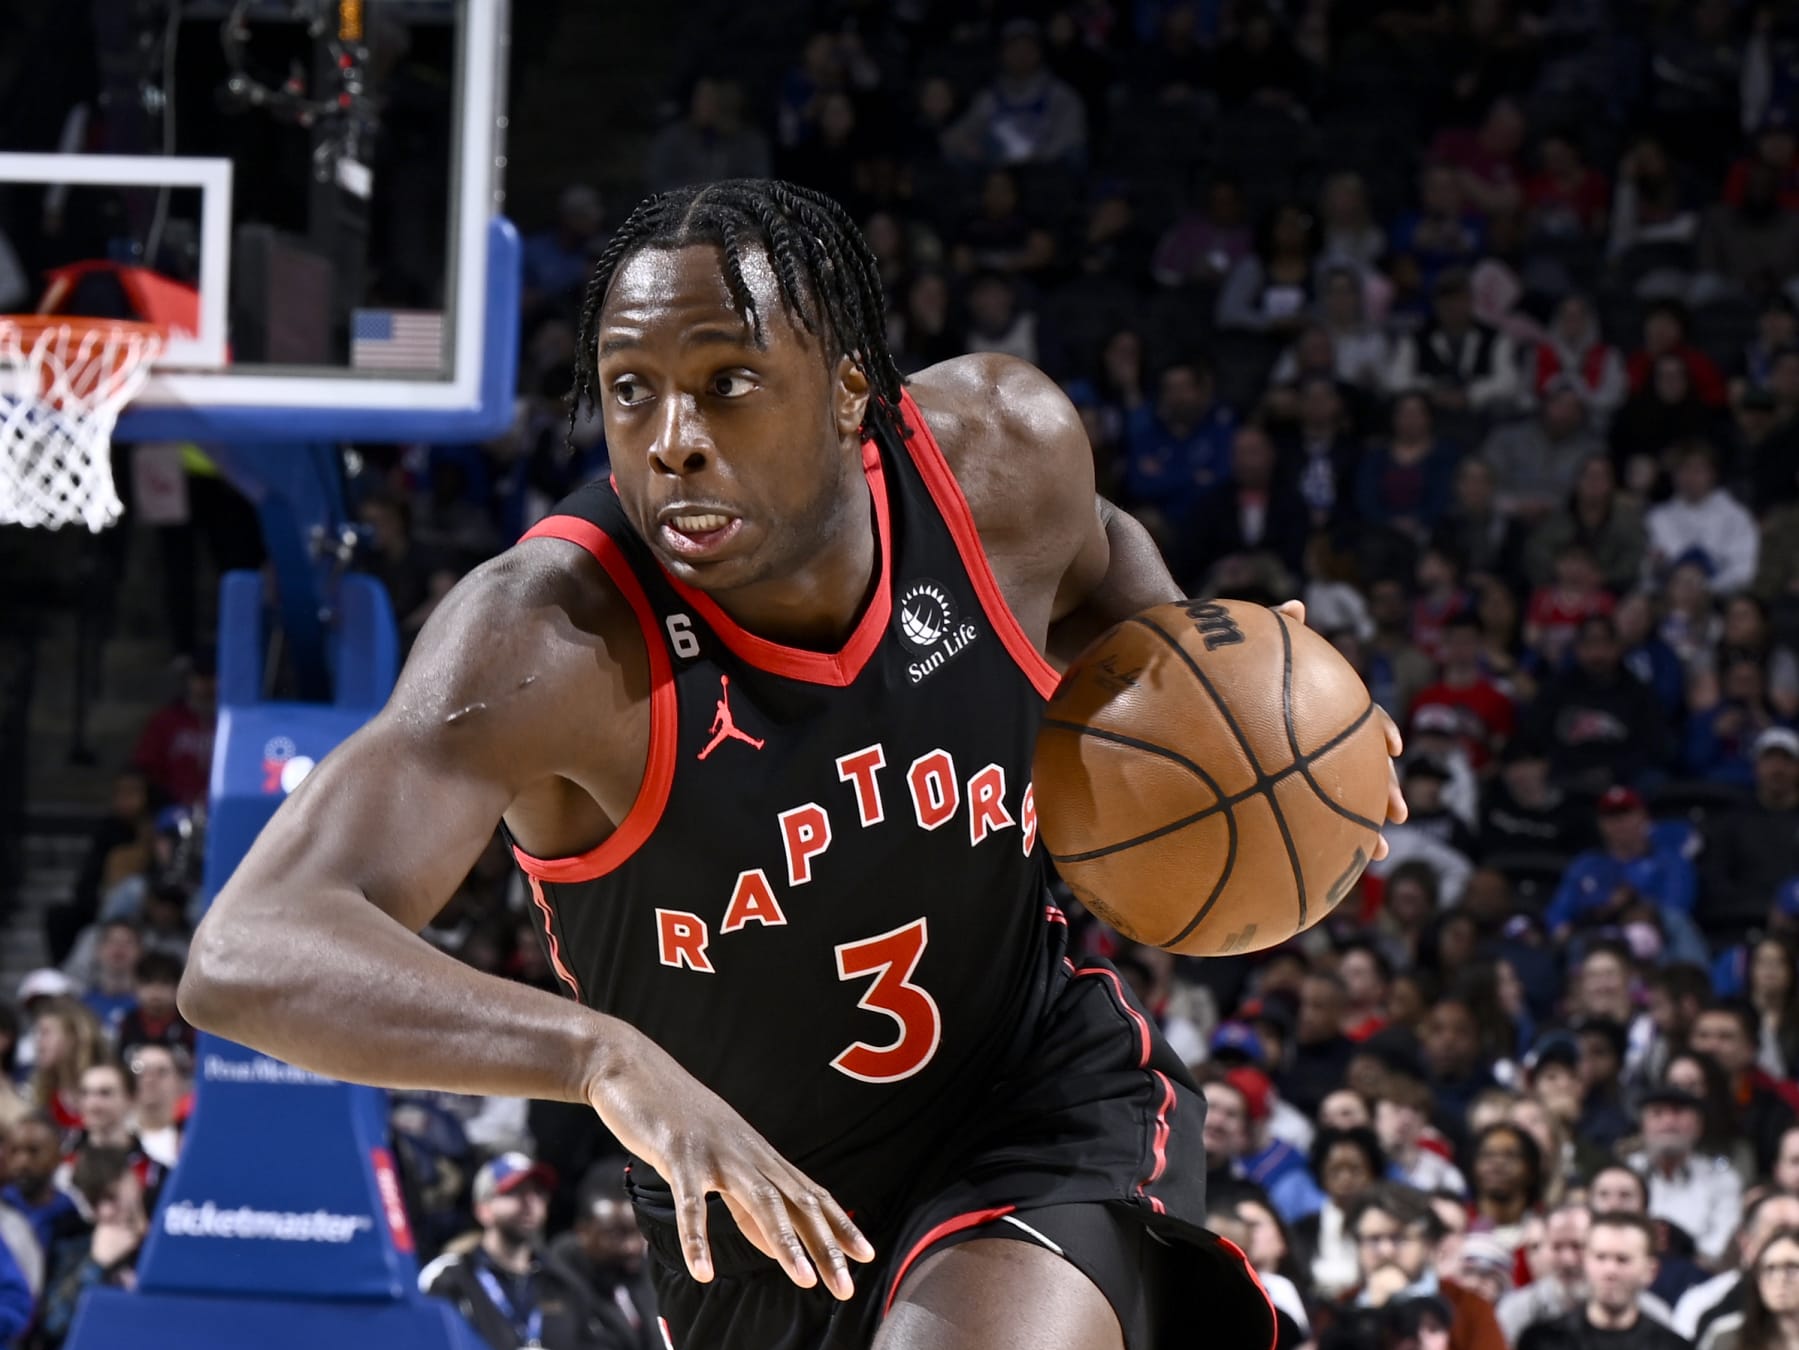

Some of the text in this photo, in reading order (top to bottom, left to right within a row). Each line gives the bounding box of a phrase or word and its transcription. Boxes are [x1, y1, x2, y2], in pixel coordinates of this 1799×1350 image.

[665, 612, 700, 660] 6
[908, 623, 977, 683] Sun Life
[829, 916, 942, 1084] 3
[164, 1200, 354, 1243] ticketmaster
